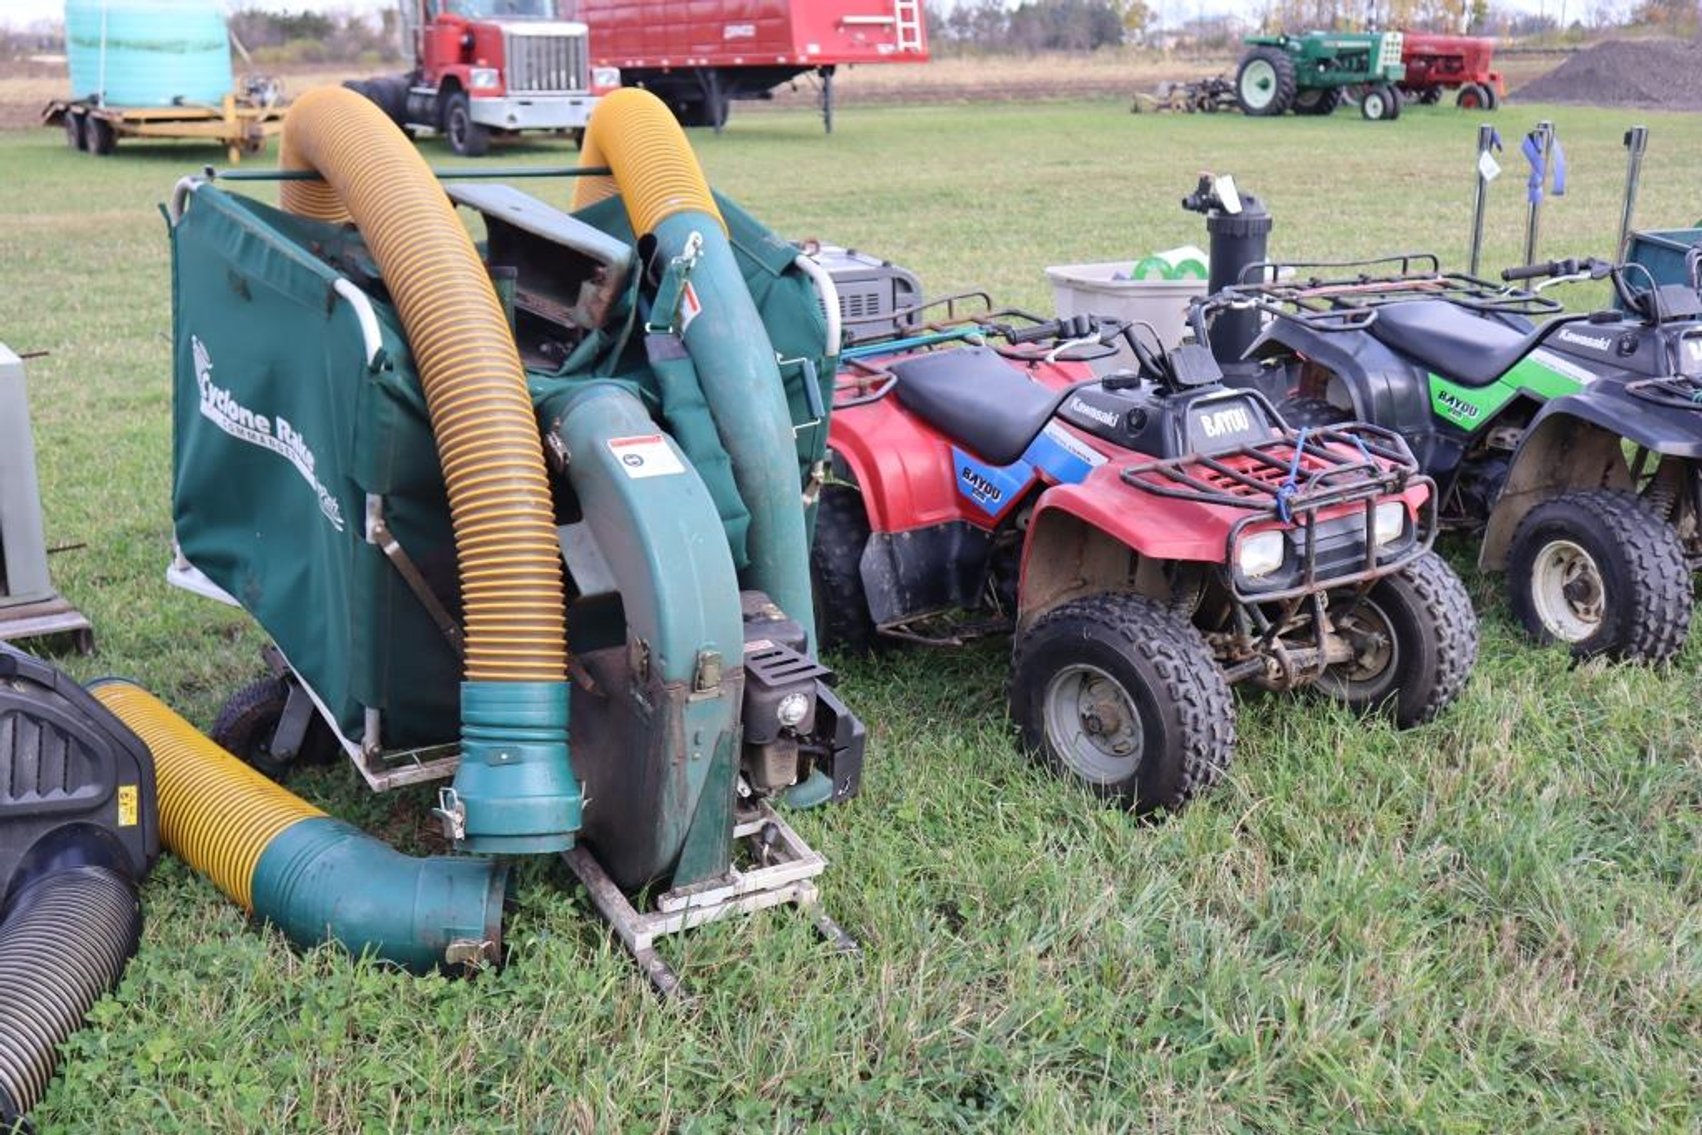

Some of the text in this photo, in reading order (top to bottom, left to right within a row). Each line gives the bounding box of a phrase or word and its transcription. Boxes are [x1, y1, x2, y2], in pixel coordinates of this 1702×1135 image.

[1558, 329, 1612, 351] Kawasaki
[1070, 397, 1120, 428] Kawasaki
[1438, 390, 1478, 418] BAYOU
[201, 372, 315, 472] Cyclone Rake
[1200, 407, 1250, 438] BAYOU
[962, 466, 1001, 501] BAYOU
